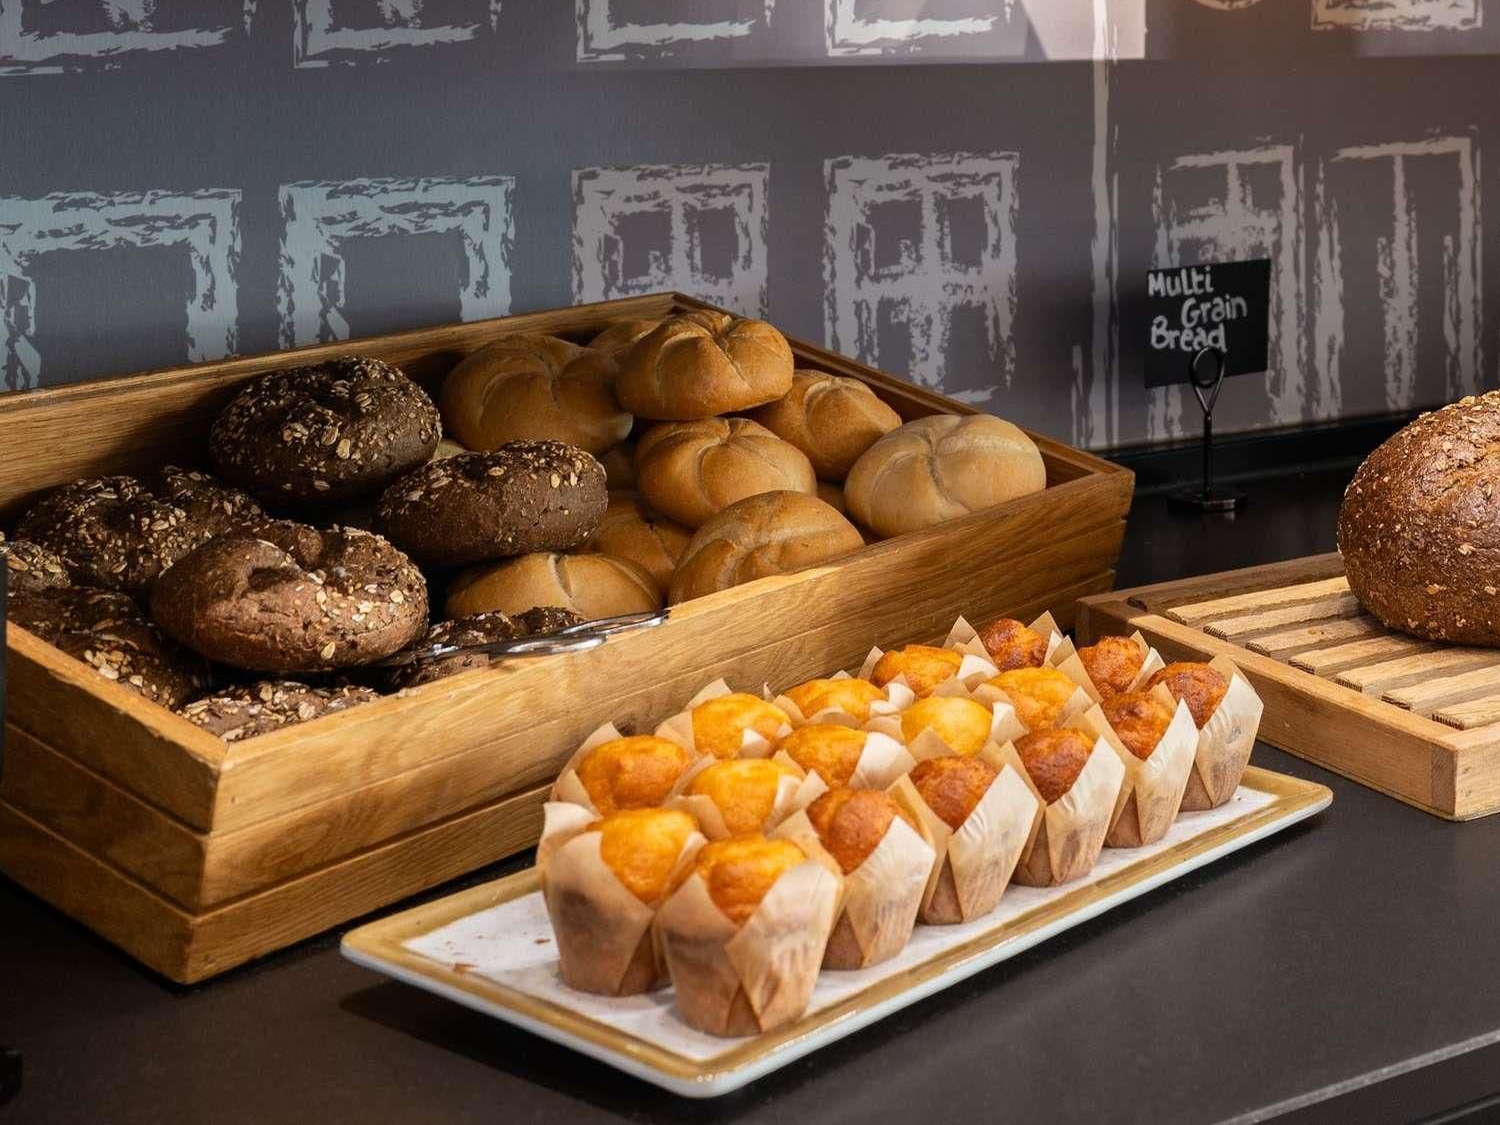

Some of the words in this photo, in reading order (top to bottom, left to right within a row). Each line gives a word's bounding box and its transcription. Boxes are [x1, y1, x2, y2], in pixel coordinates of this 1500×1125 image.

[1147, 265, 1214, 297] Multi
[1180, 293, 1248, 329] Grain
[1150, 314, 1228, 353] Bread
